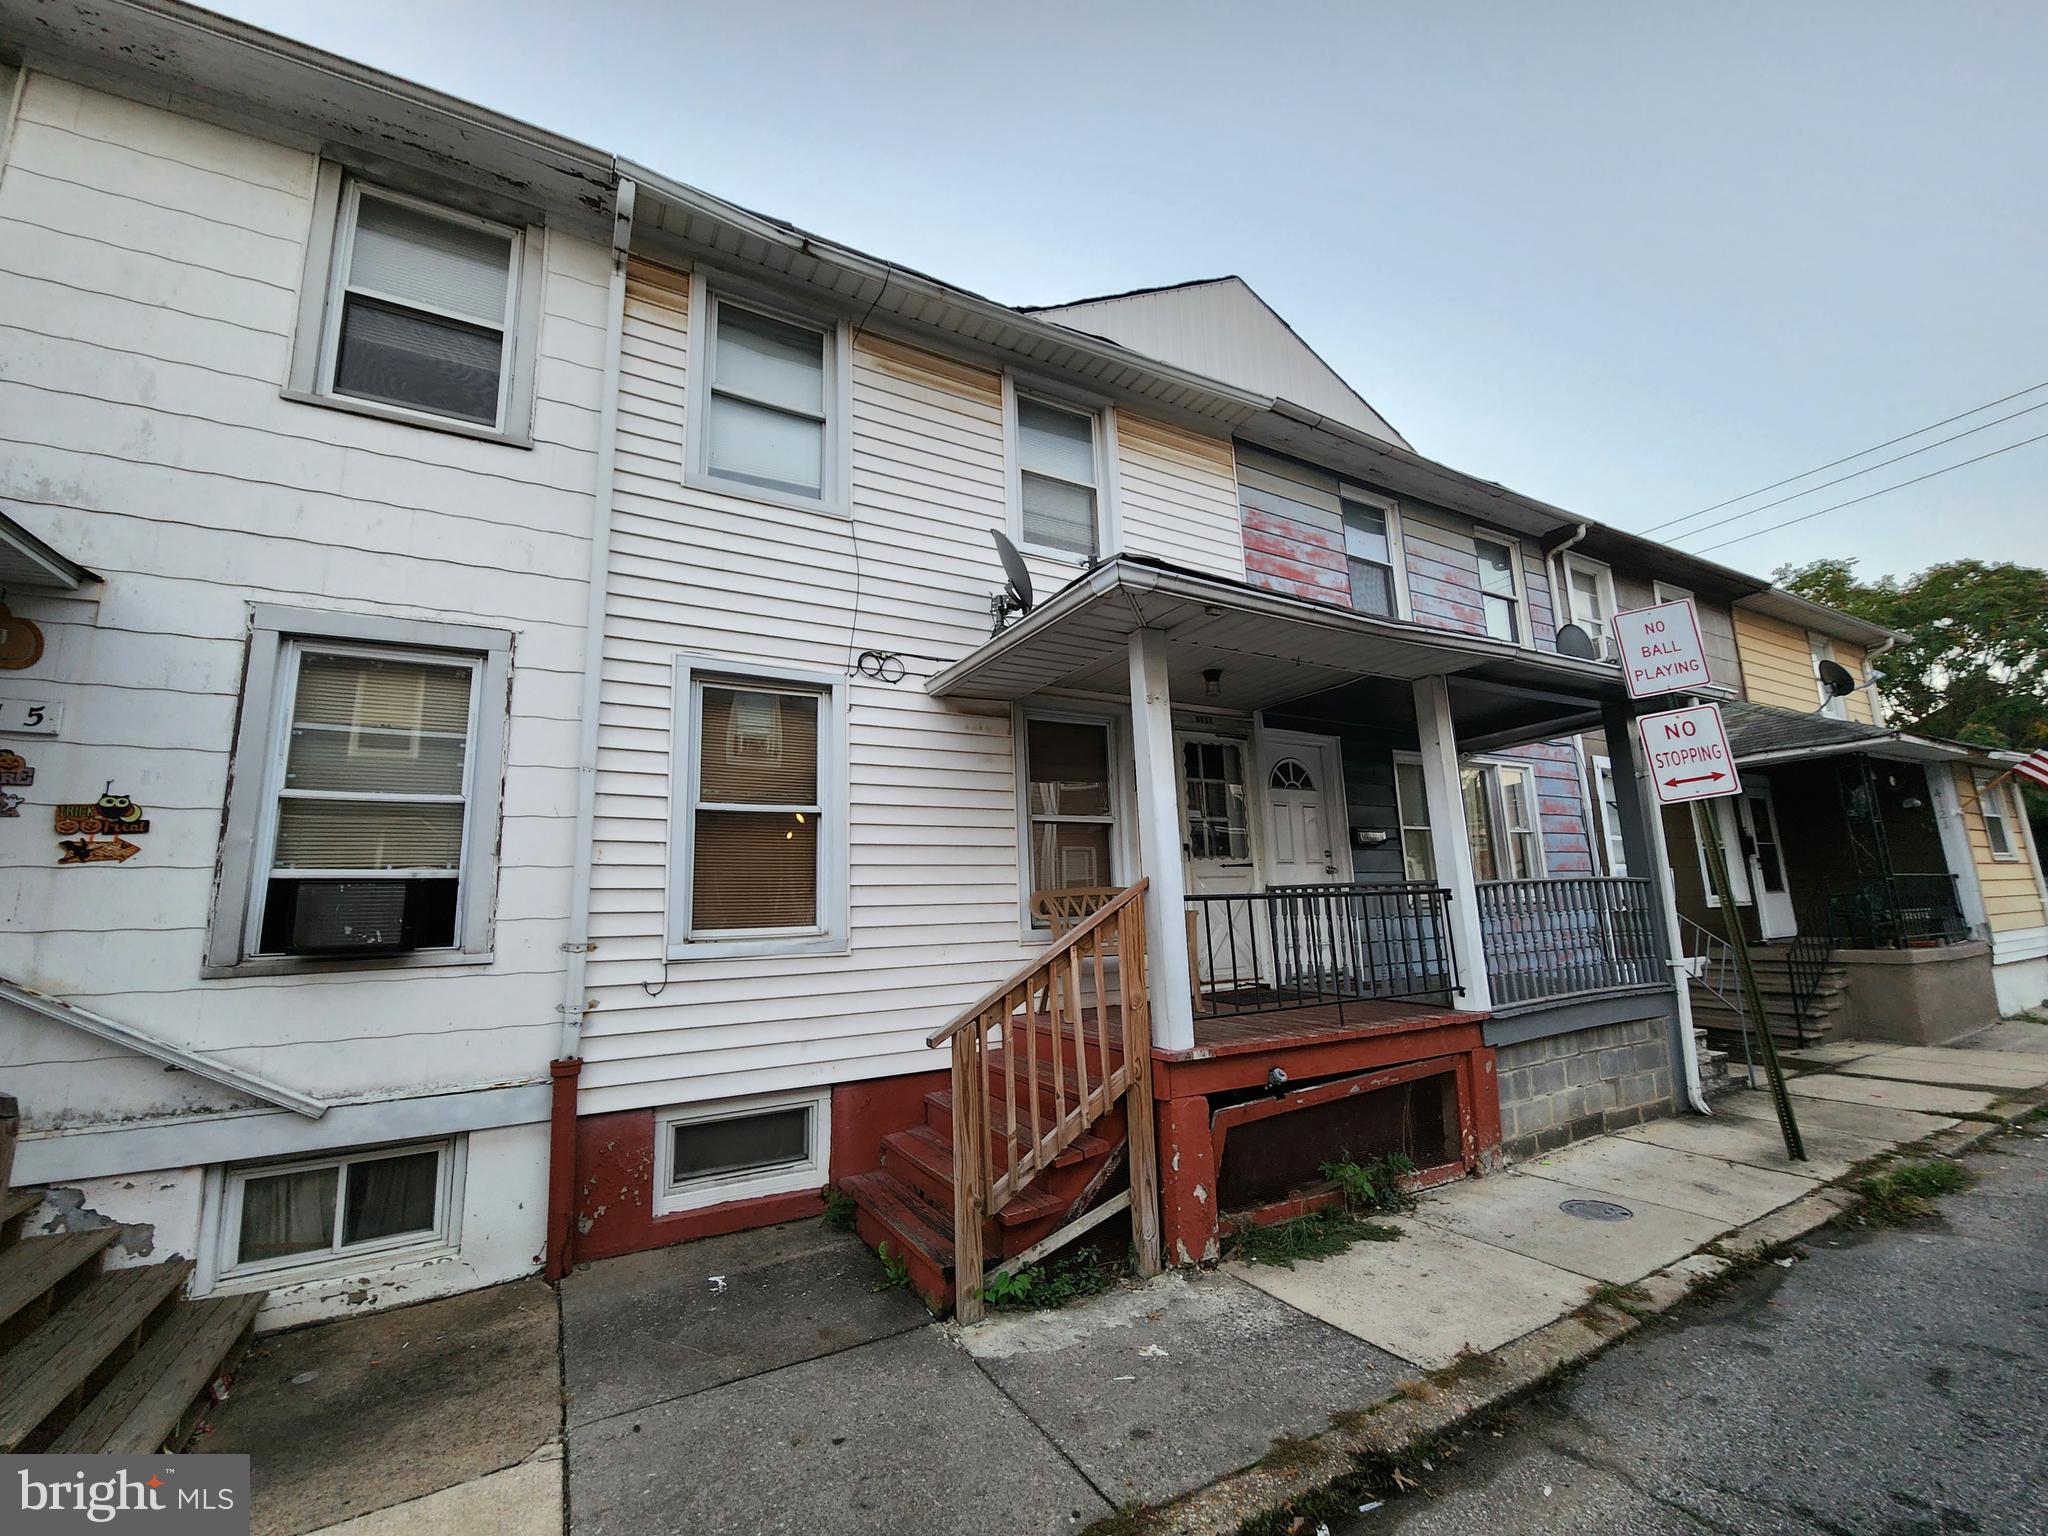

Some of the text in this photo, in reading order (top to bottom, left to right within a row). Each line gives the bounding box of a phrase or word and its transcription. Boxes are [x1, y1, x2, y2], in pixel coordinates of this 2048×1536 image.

[1644, 620, 1665, 635] NO
[1641, 640, 1682, 658] BALL
[1635, 659, 1700, 682] PLAYING
[1664, 720, 1696, 740] NO
[1655, 744, 1722, 769] STOPPING
